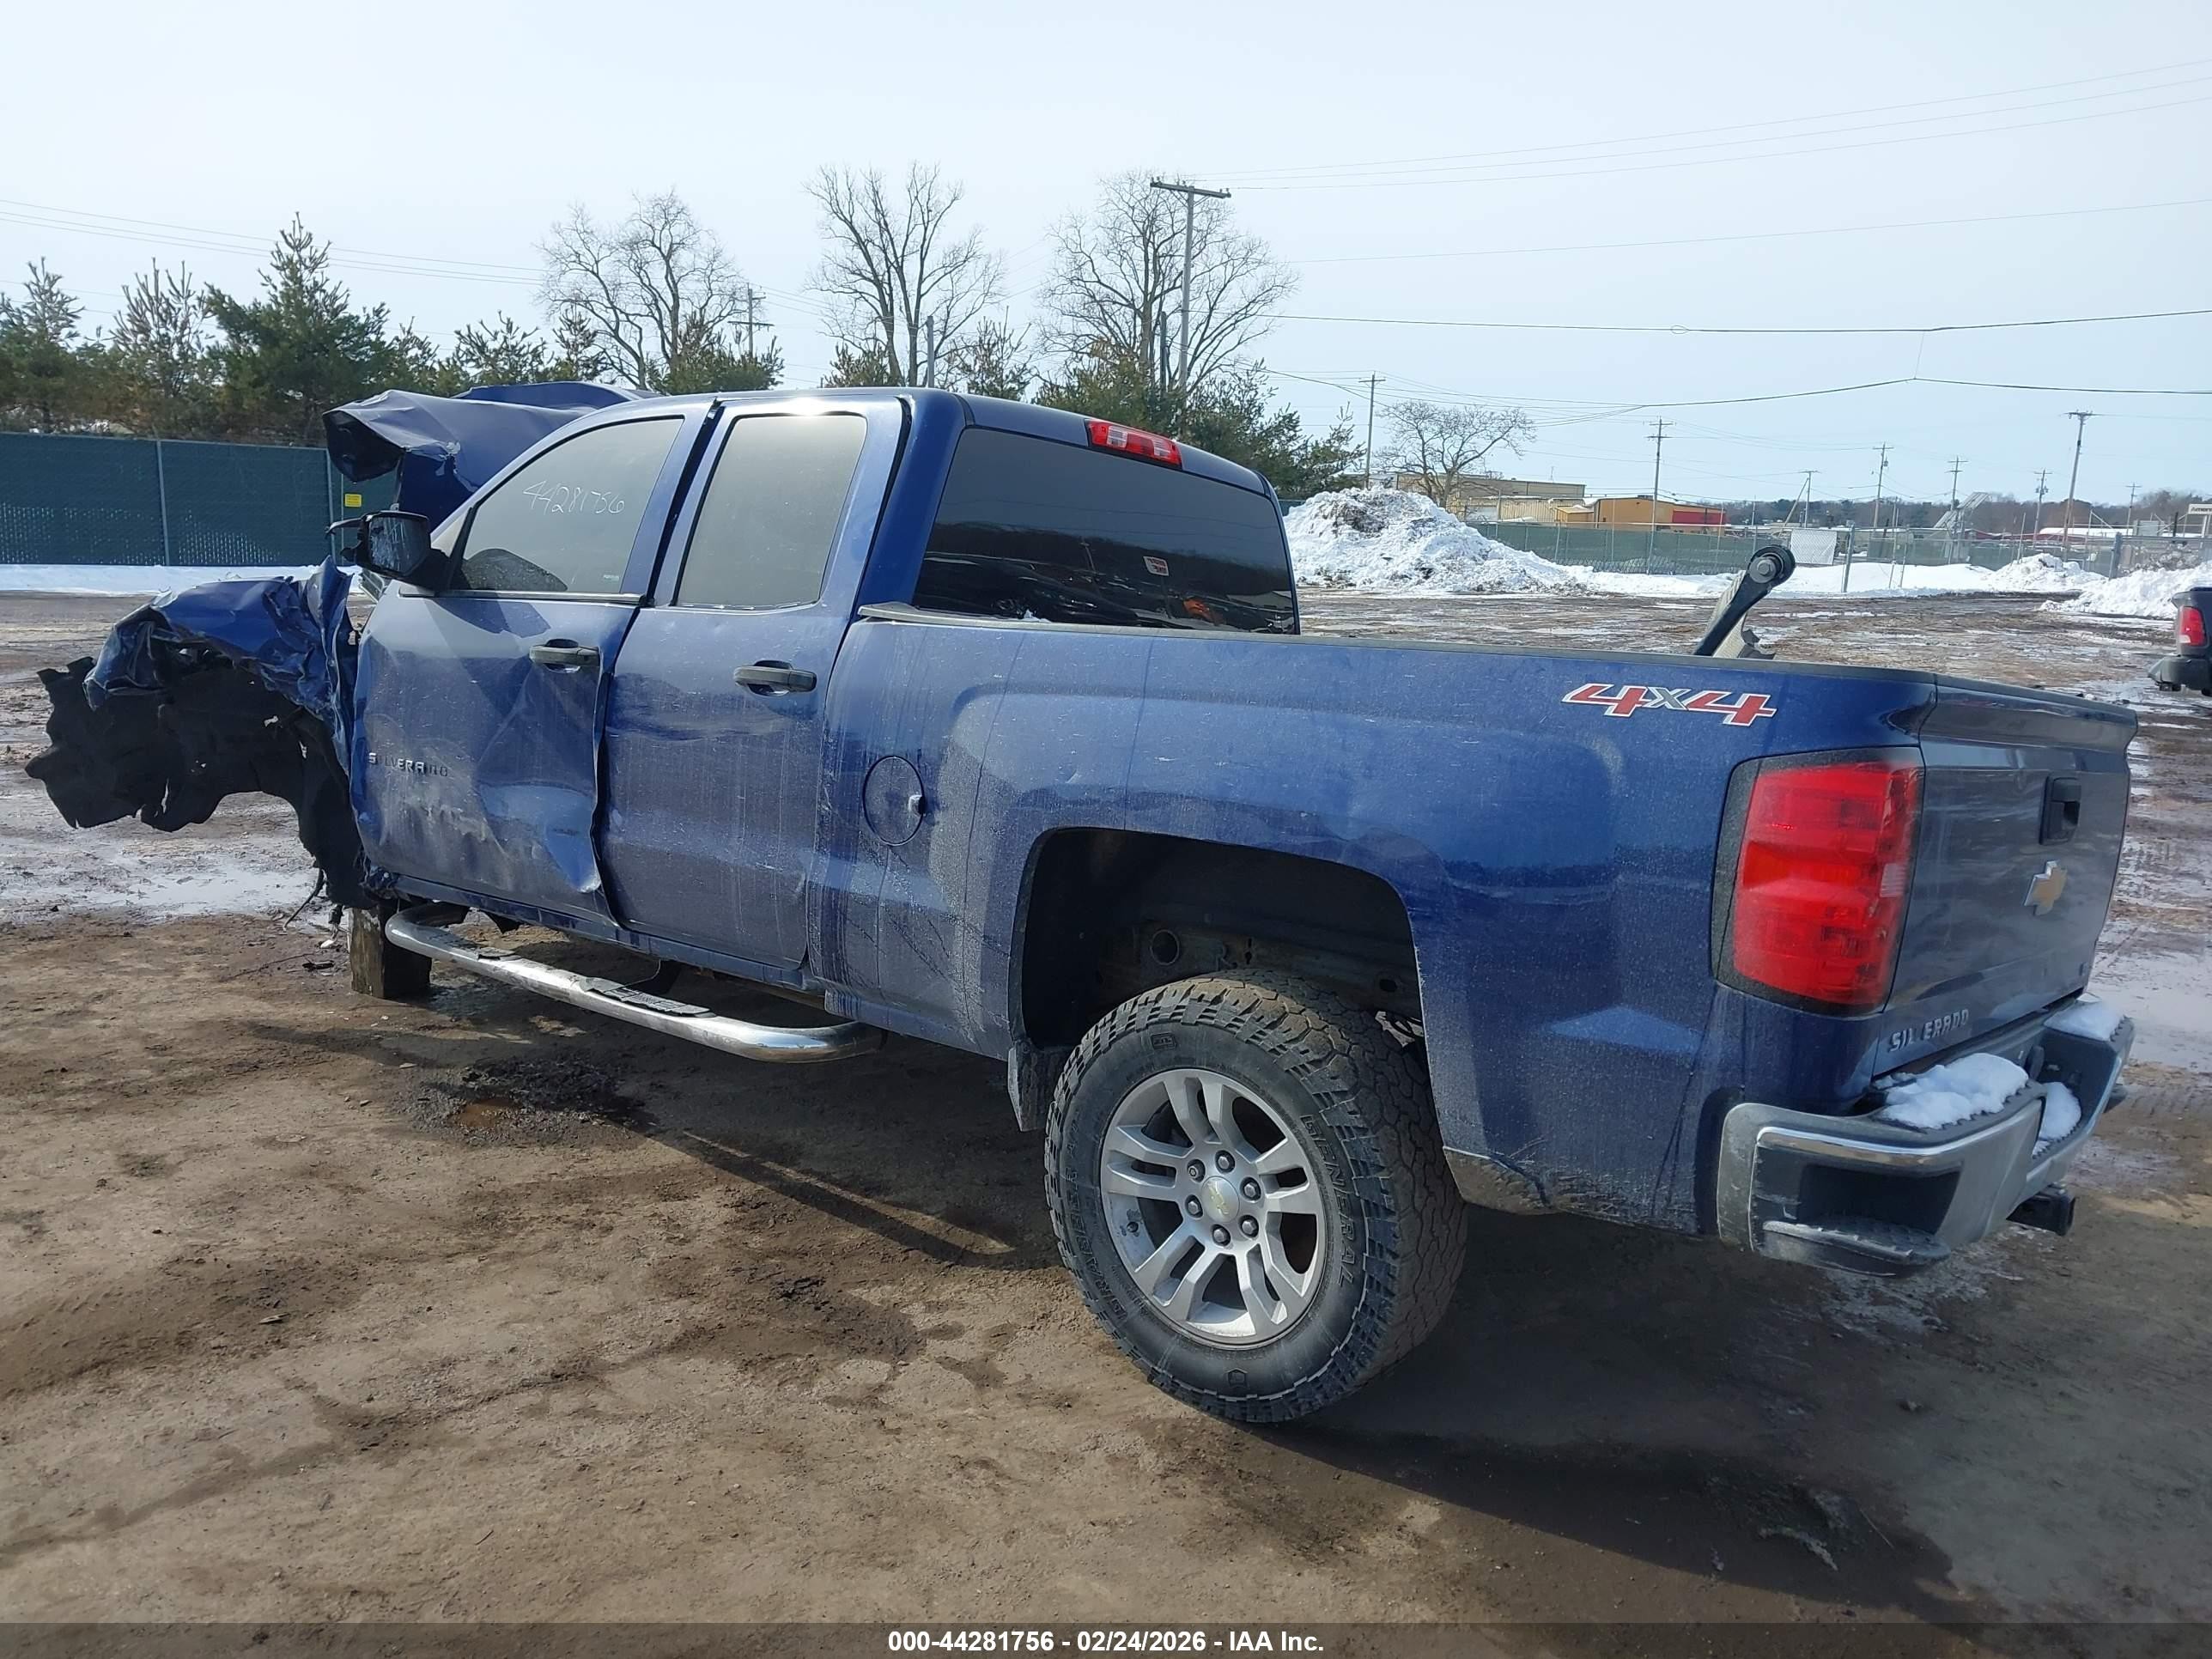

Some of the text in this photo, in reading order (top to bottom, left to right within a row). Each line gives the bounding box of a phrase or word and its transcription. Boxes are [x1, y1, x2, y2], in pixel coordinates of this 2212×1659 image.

[523, 481, 625, 515] 44281756
[1888, 1008, 1969, 1052] SILERADO
[1300, 1114, 1356, 1287] GENERAL
